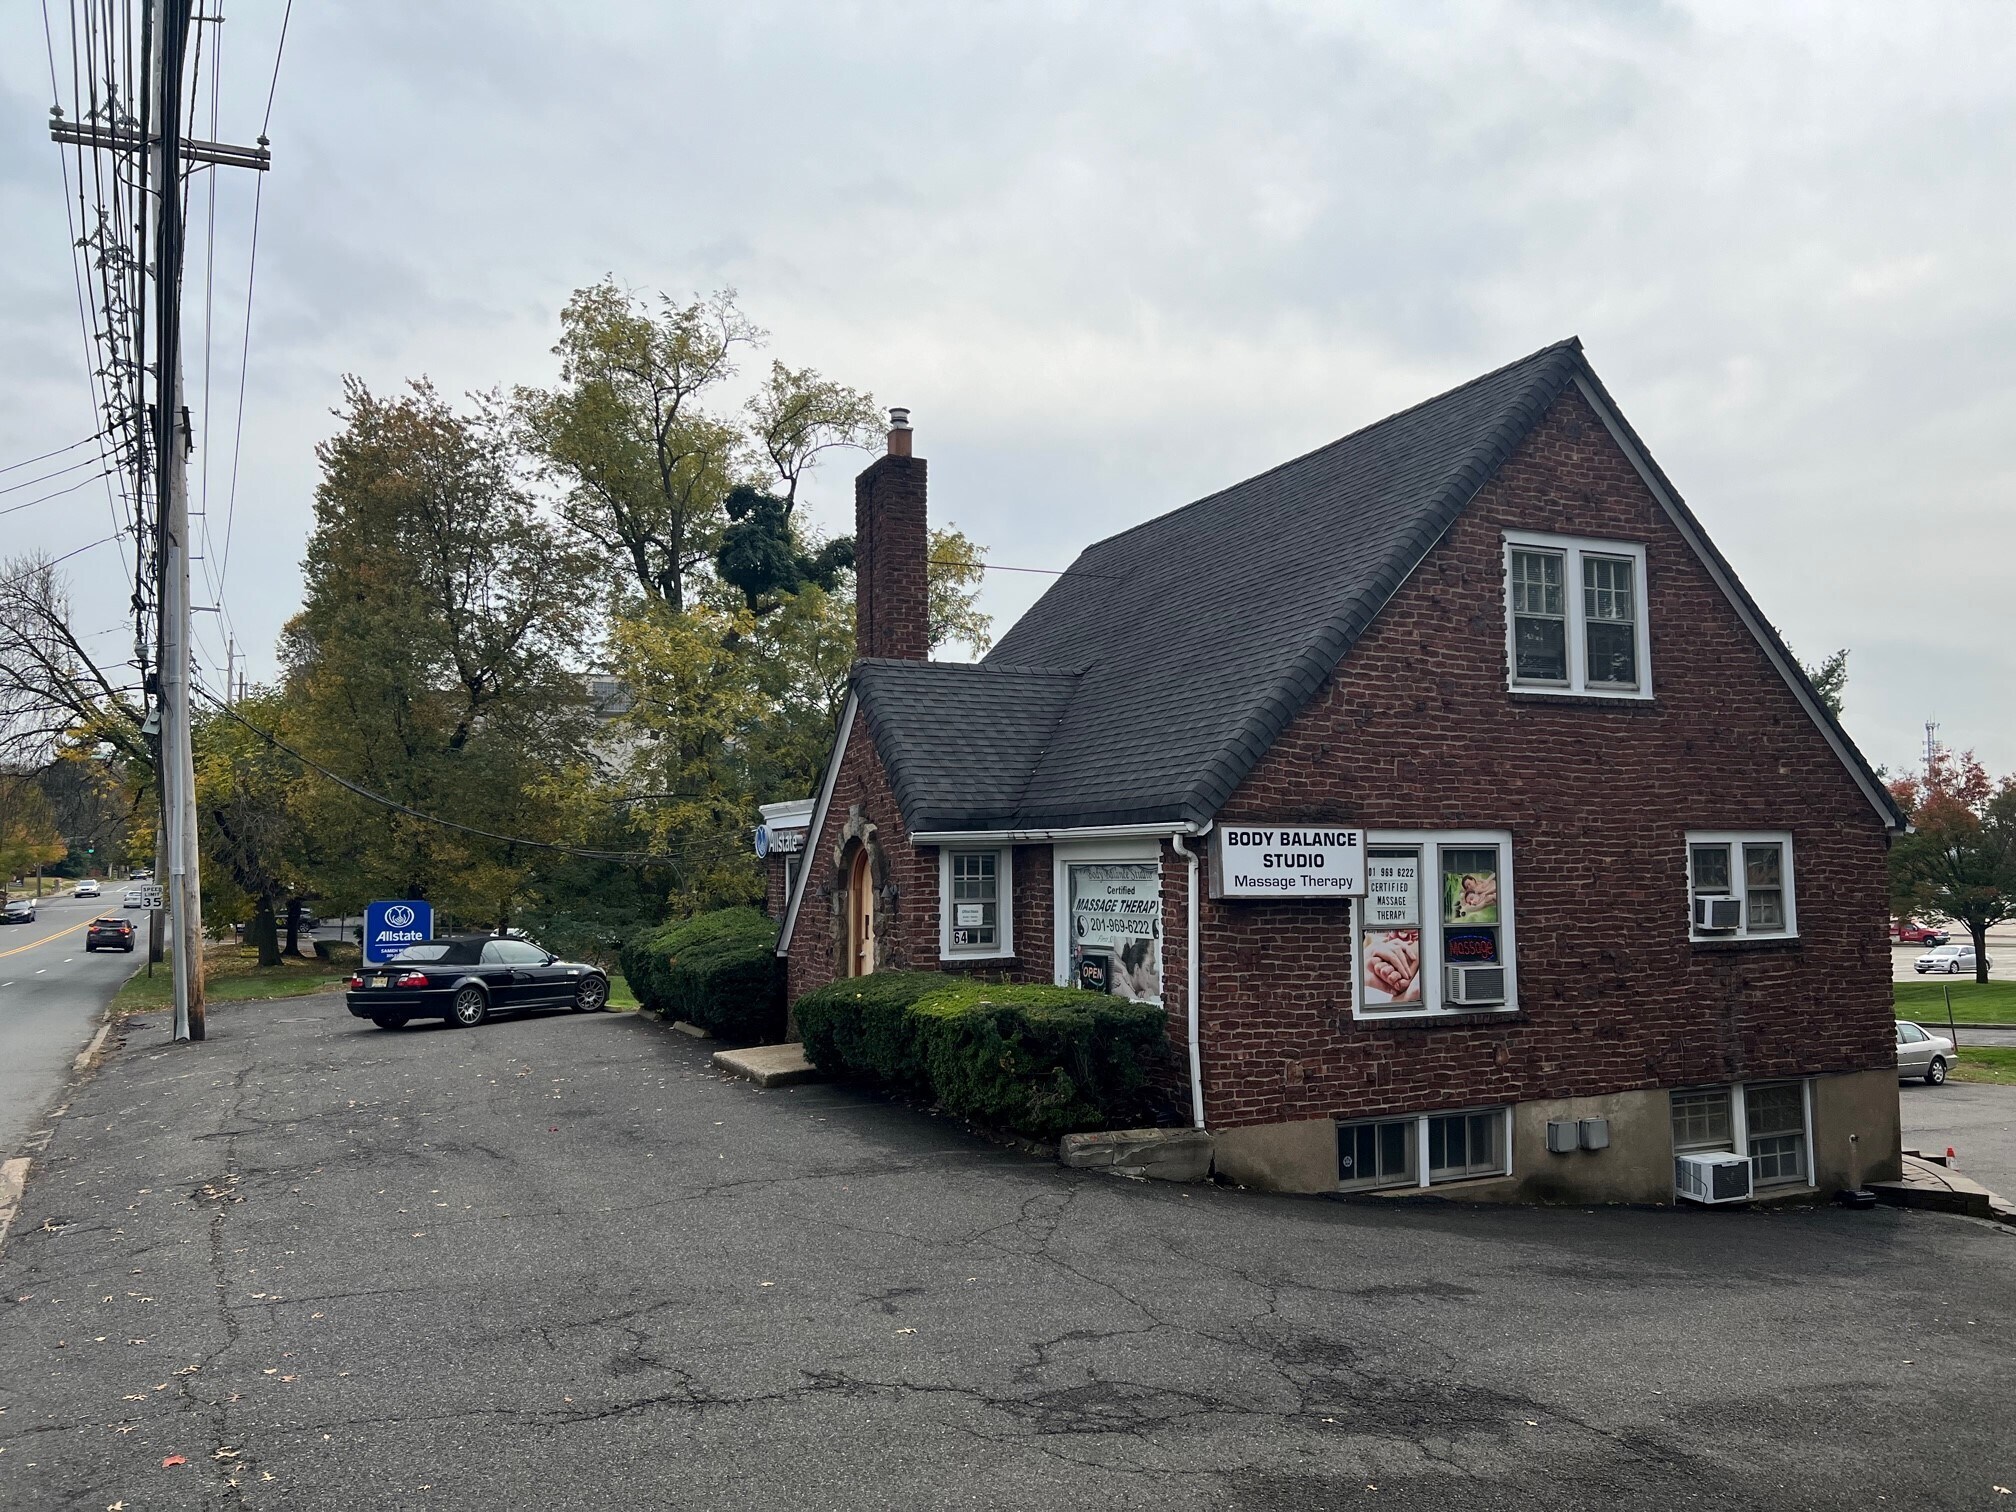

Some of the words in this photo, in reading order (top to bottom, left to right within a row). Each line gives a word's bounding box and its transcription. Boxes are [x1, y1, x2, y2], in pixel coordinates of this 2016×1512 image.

[768, 832, 797, 852] Allstate
[1228, 831, 1274, 847] BODY
[1280, 832, 1357, 847] BALANCE
[1263, 853, 1325, 868] STUDIO
[1380, 867, 1393, 877] 969
[1397, 868, 1414, 878] 6222
[1234, 875, 1296, 890] Massage
[1300, 875, 1353, 890] Therapy
[1370, 882, 1408, 892] CERTIFIED
[1107, 885, 1135, 895] Certified
[143, 898, 162, 907] 35
[1076, 899, 1118, 912] MASSAGE
[1377, 896, 1406, 906] MASSAGE
[1377, 910, 1406, 920] THERAPY
[1090, 918, 1150, 935] 201-969-6222
[376, 930, 422, 942] Allstate
[954, 931, 967, 944] 64
[1449, 940, 1494, 958] Massage
[1083, 967, 1103, 980] OPEN
